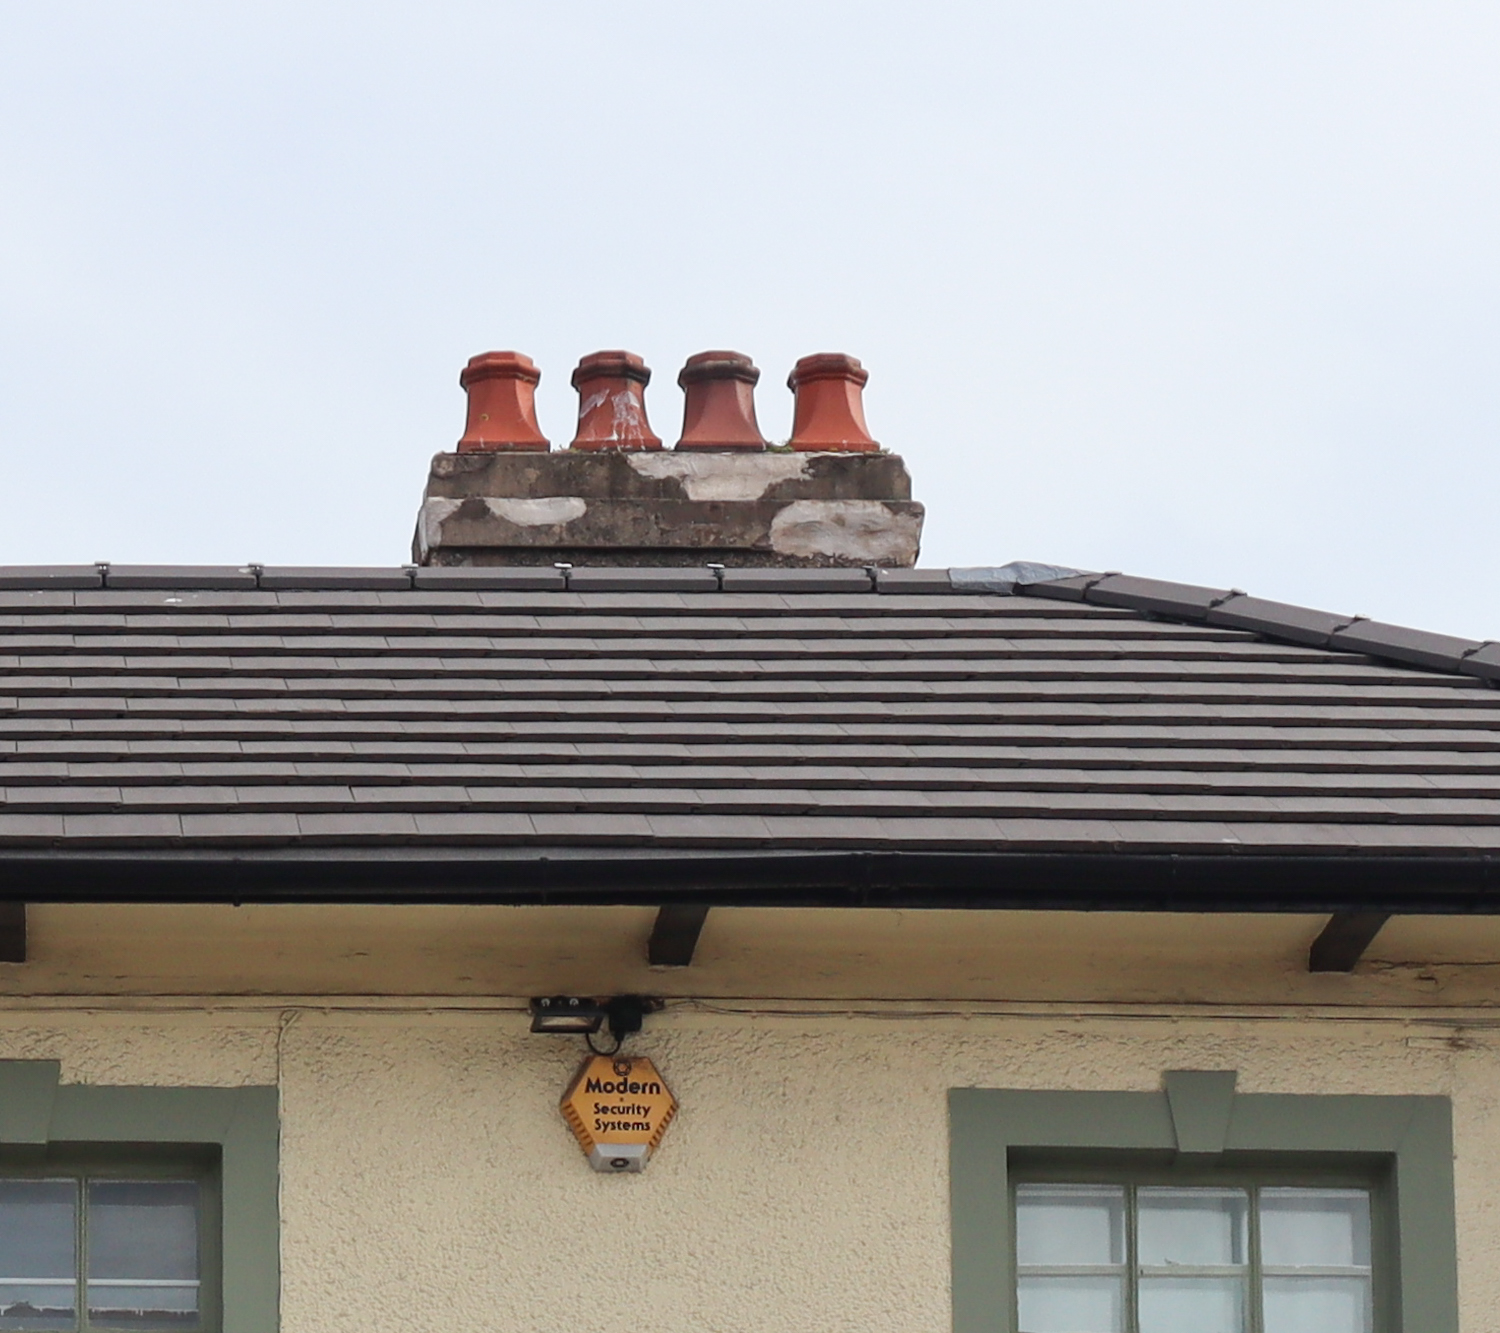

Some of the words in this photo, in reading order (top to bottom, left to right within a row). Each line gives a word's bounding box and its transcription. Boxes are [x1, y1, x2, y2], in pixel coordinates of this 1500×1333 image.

[585, 1077, 661, 1095] Modern
[593, 1102, 651, 1118] Security
[594, 1118, 651, 1133] Systems
